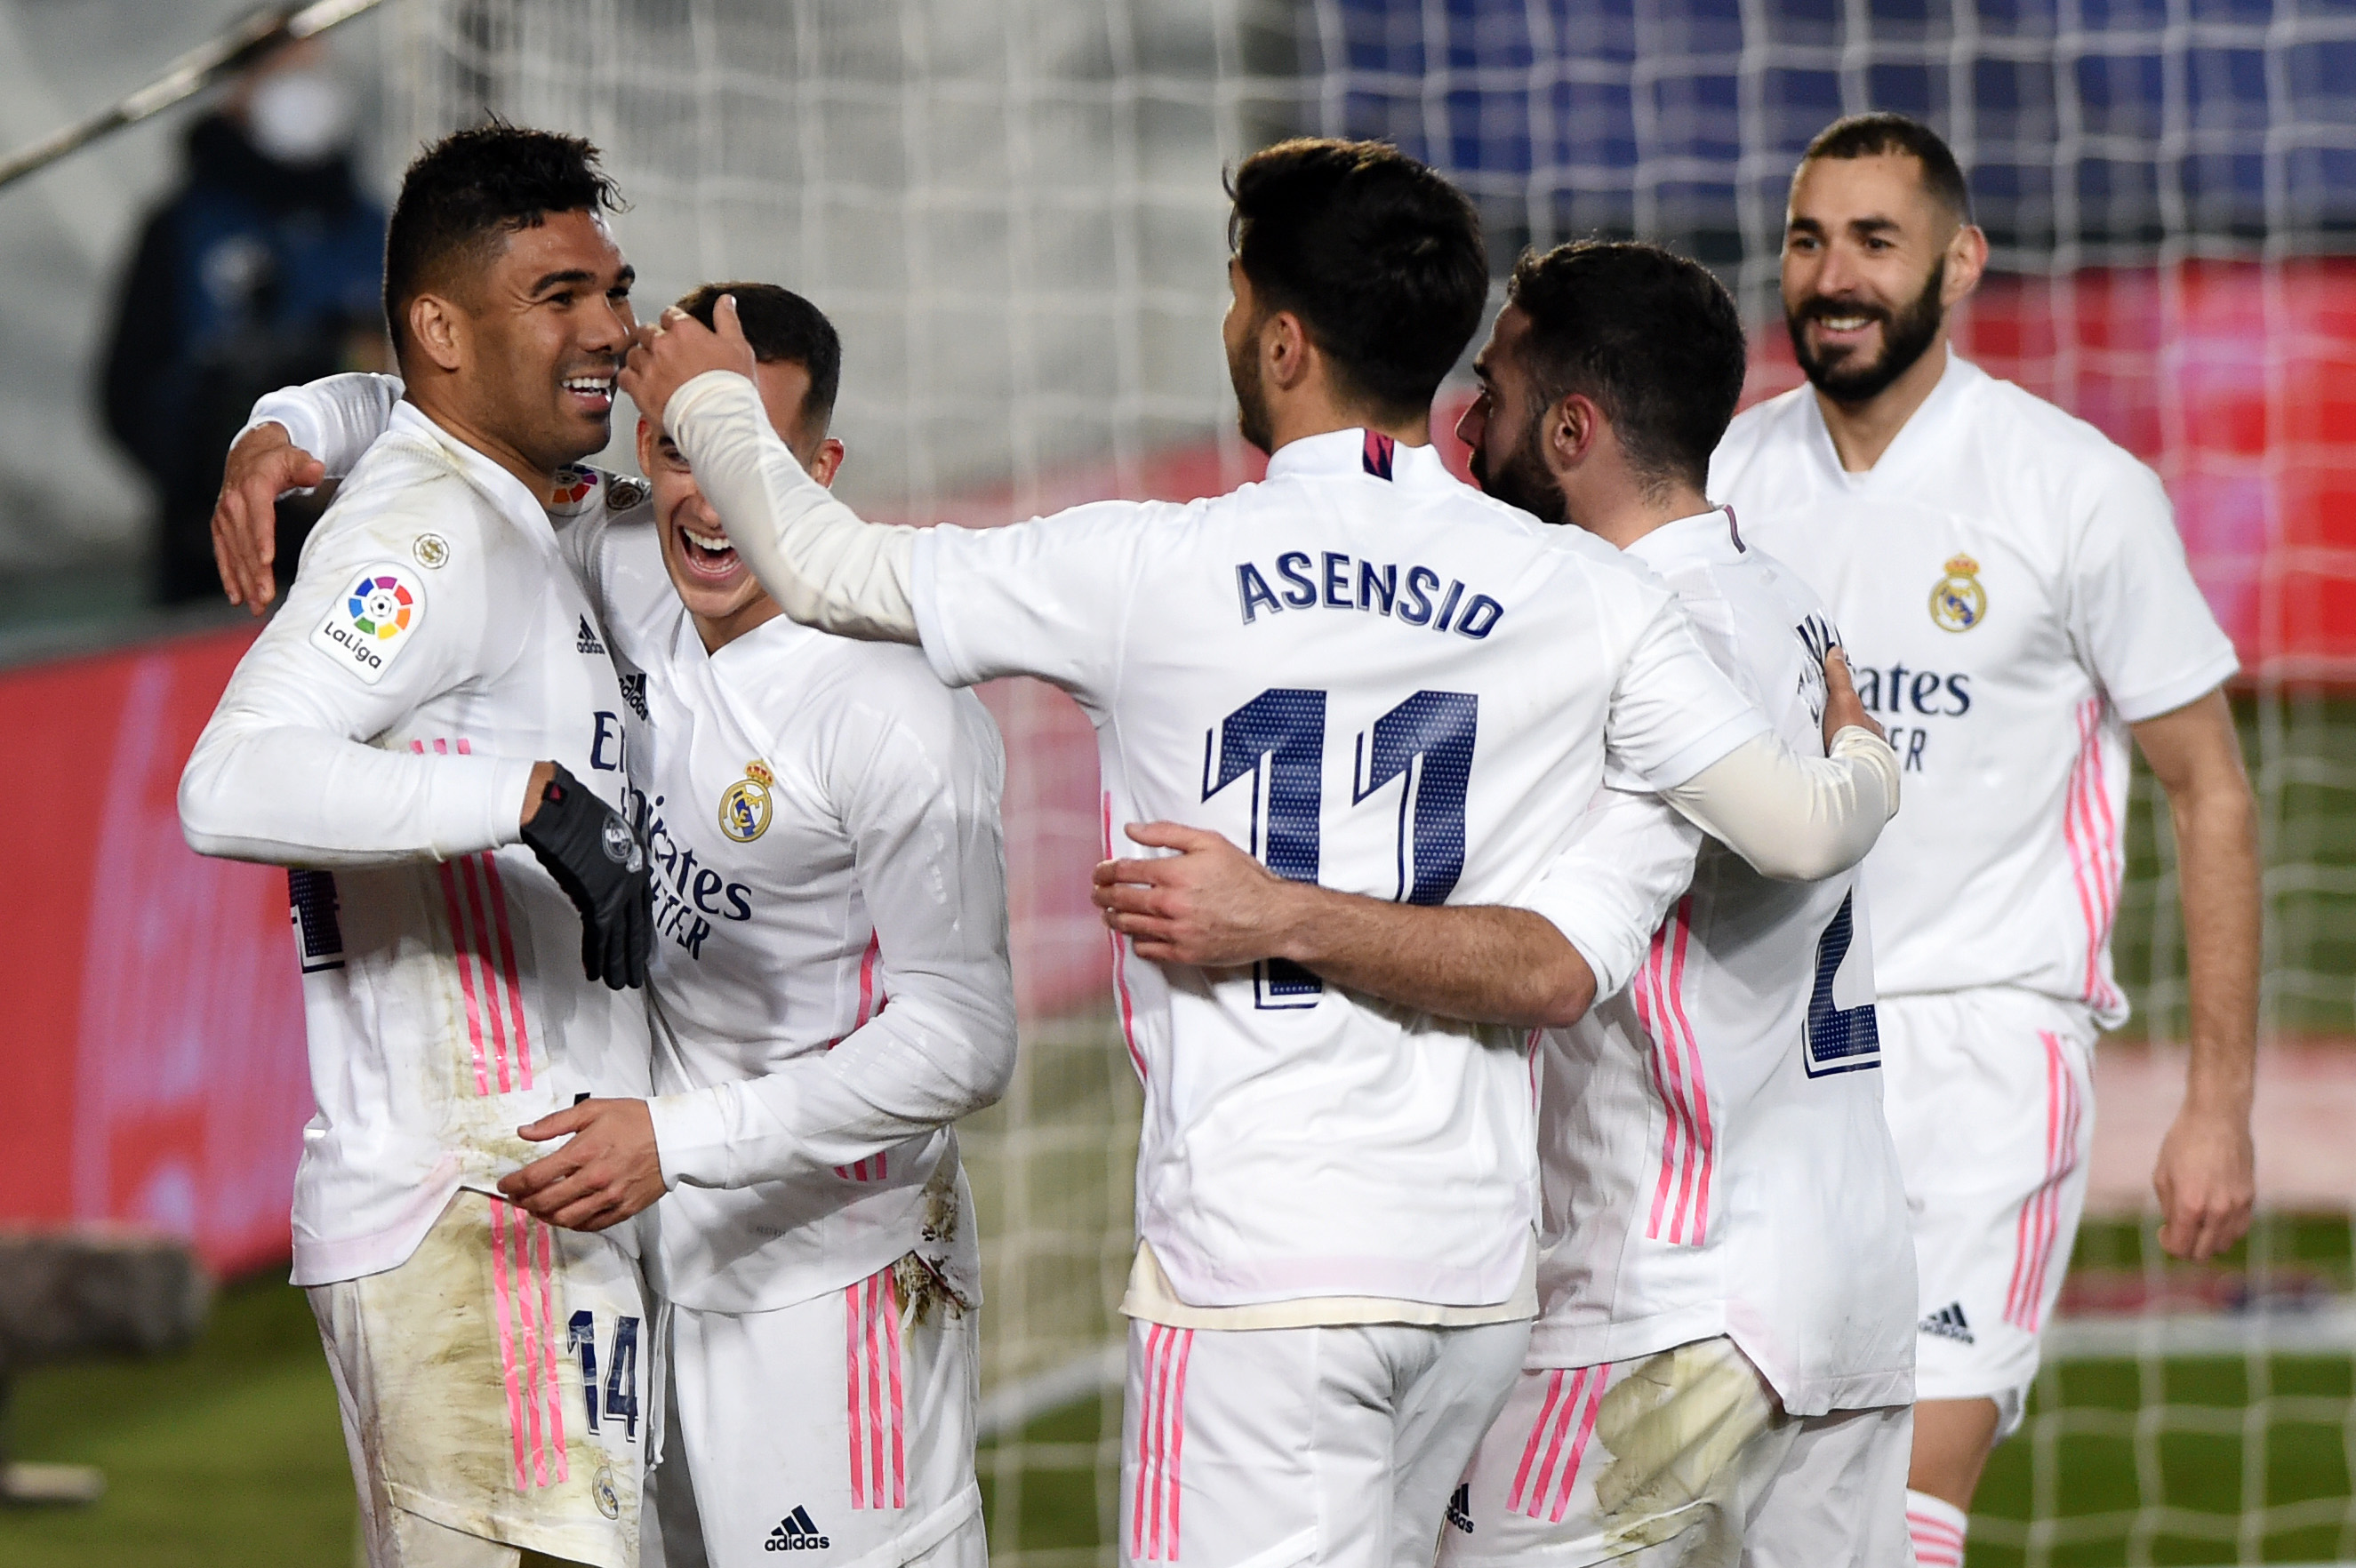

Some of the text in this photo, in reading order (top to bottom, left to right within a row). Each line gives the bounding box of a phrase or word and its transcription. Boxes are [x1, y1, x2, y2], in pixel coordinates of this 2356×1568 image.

[1235, 550, 1504, 640] ASENSIO
[324, 621, 382, 669] LaLiga
[566, 1310, 641, 1444] 14
[764, 1533, 830, 1553] adidas
